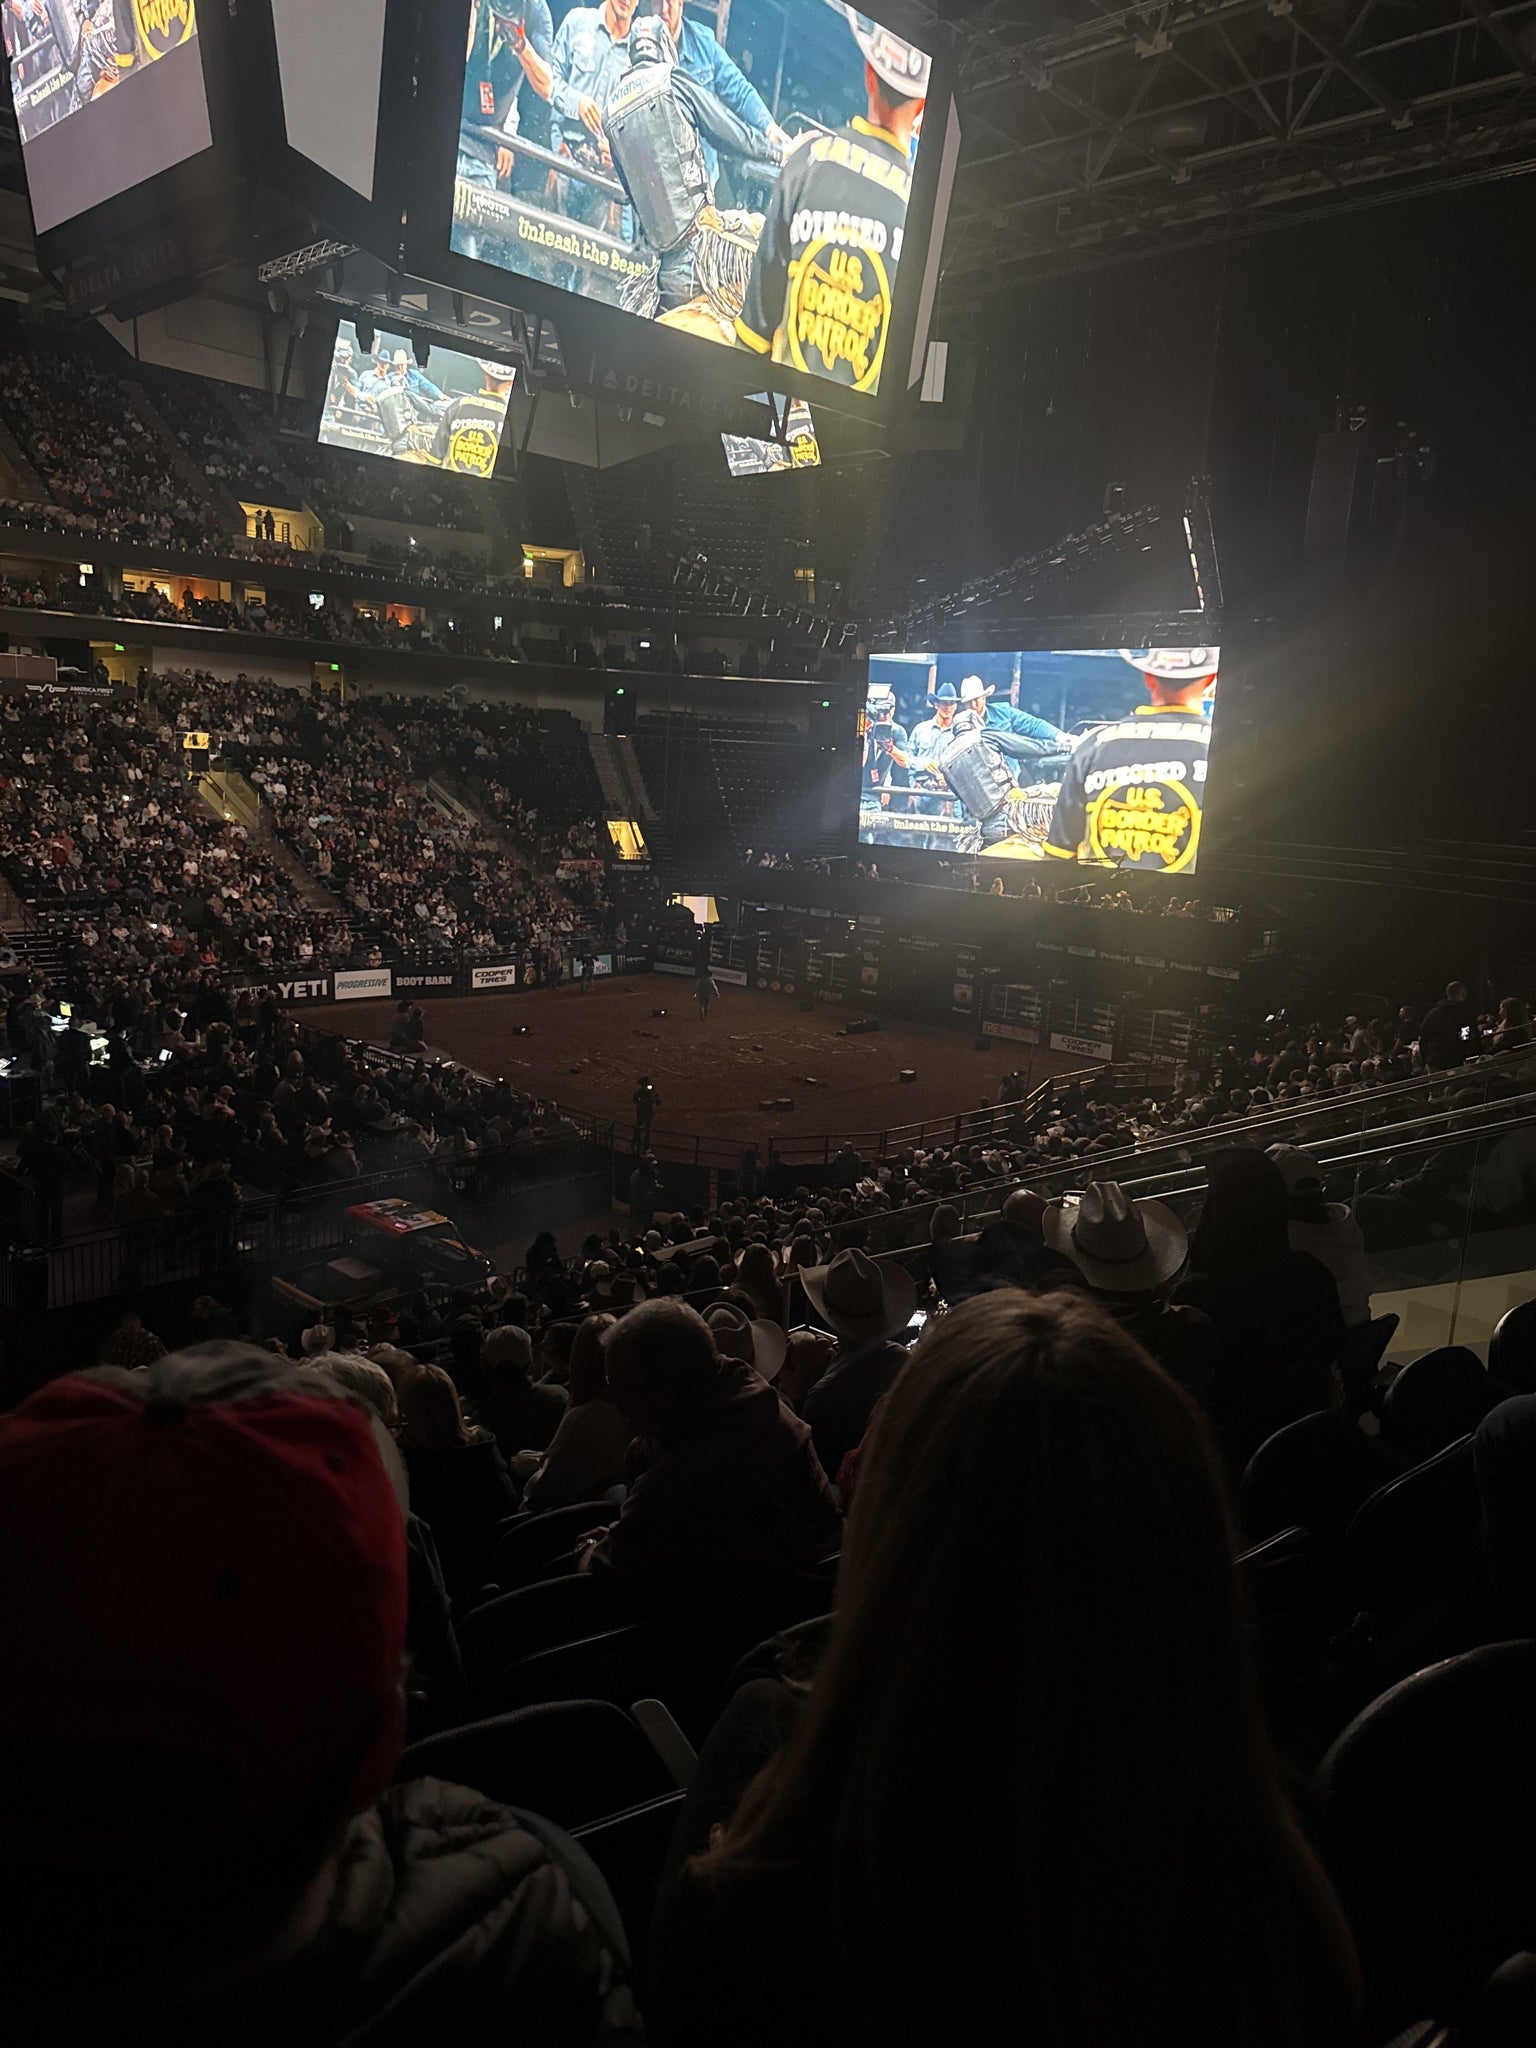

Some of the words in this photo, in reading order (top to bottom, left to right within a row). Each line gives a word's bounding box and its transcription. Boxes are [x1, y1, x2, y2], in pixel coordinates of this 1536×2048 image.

[518, 215, 581, 258] Unleash
[582, 241, 610, 267] the
[803, 277, 881, 339] BORDER
[799, 310, 869, 366] PATROL
[626, 374, 690, 409] DELTA
[894, 819, 930, 833] Unleash
[930, 822, 947, 833] the
[1101, 808, 1188, 837] BORDER
[1101, 829, 1179, 859] PATROL
[336, 977, 389, 990] PROGRESSIVE
[395, 976, 424, 987] BOOT
[424, 975, 453, 986] BARN
[475, 968, 513, 979] COOPER
[480, 975, 507, 985] TIRES
[277, 979, 328, 999] YETI
[1061, 1036, 1102, 1049] COOPER
